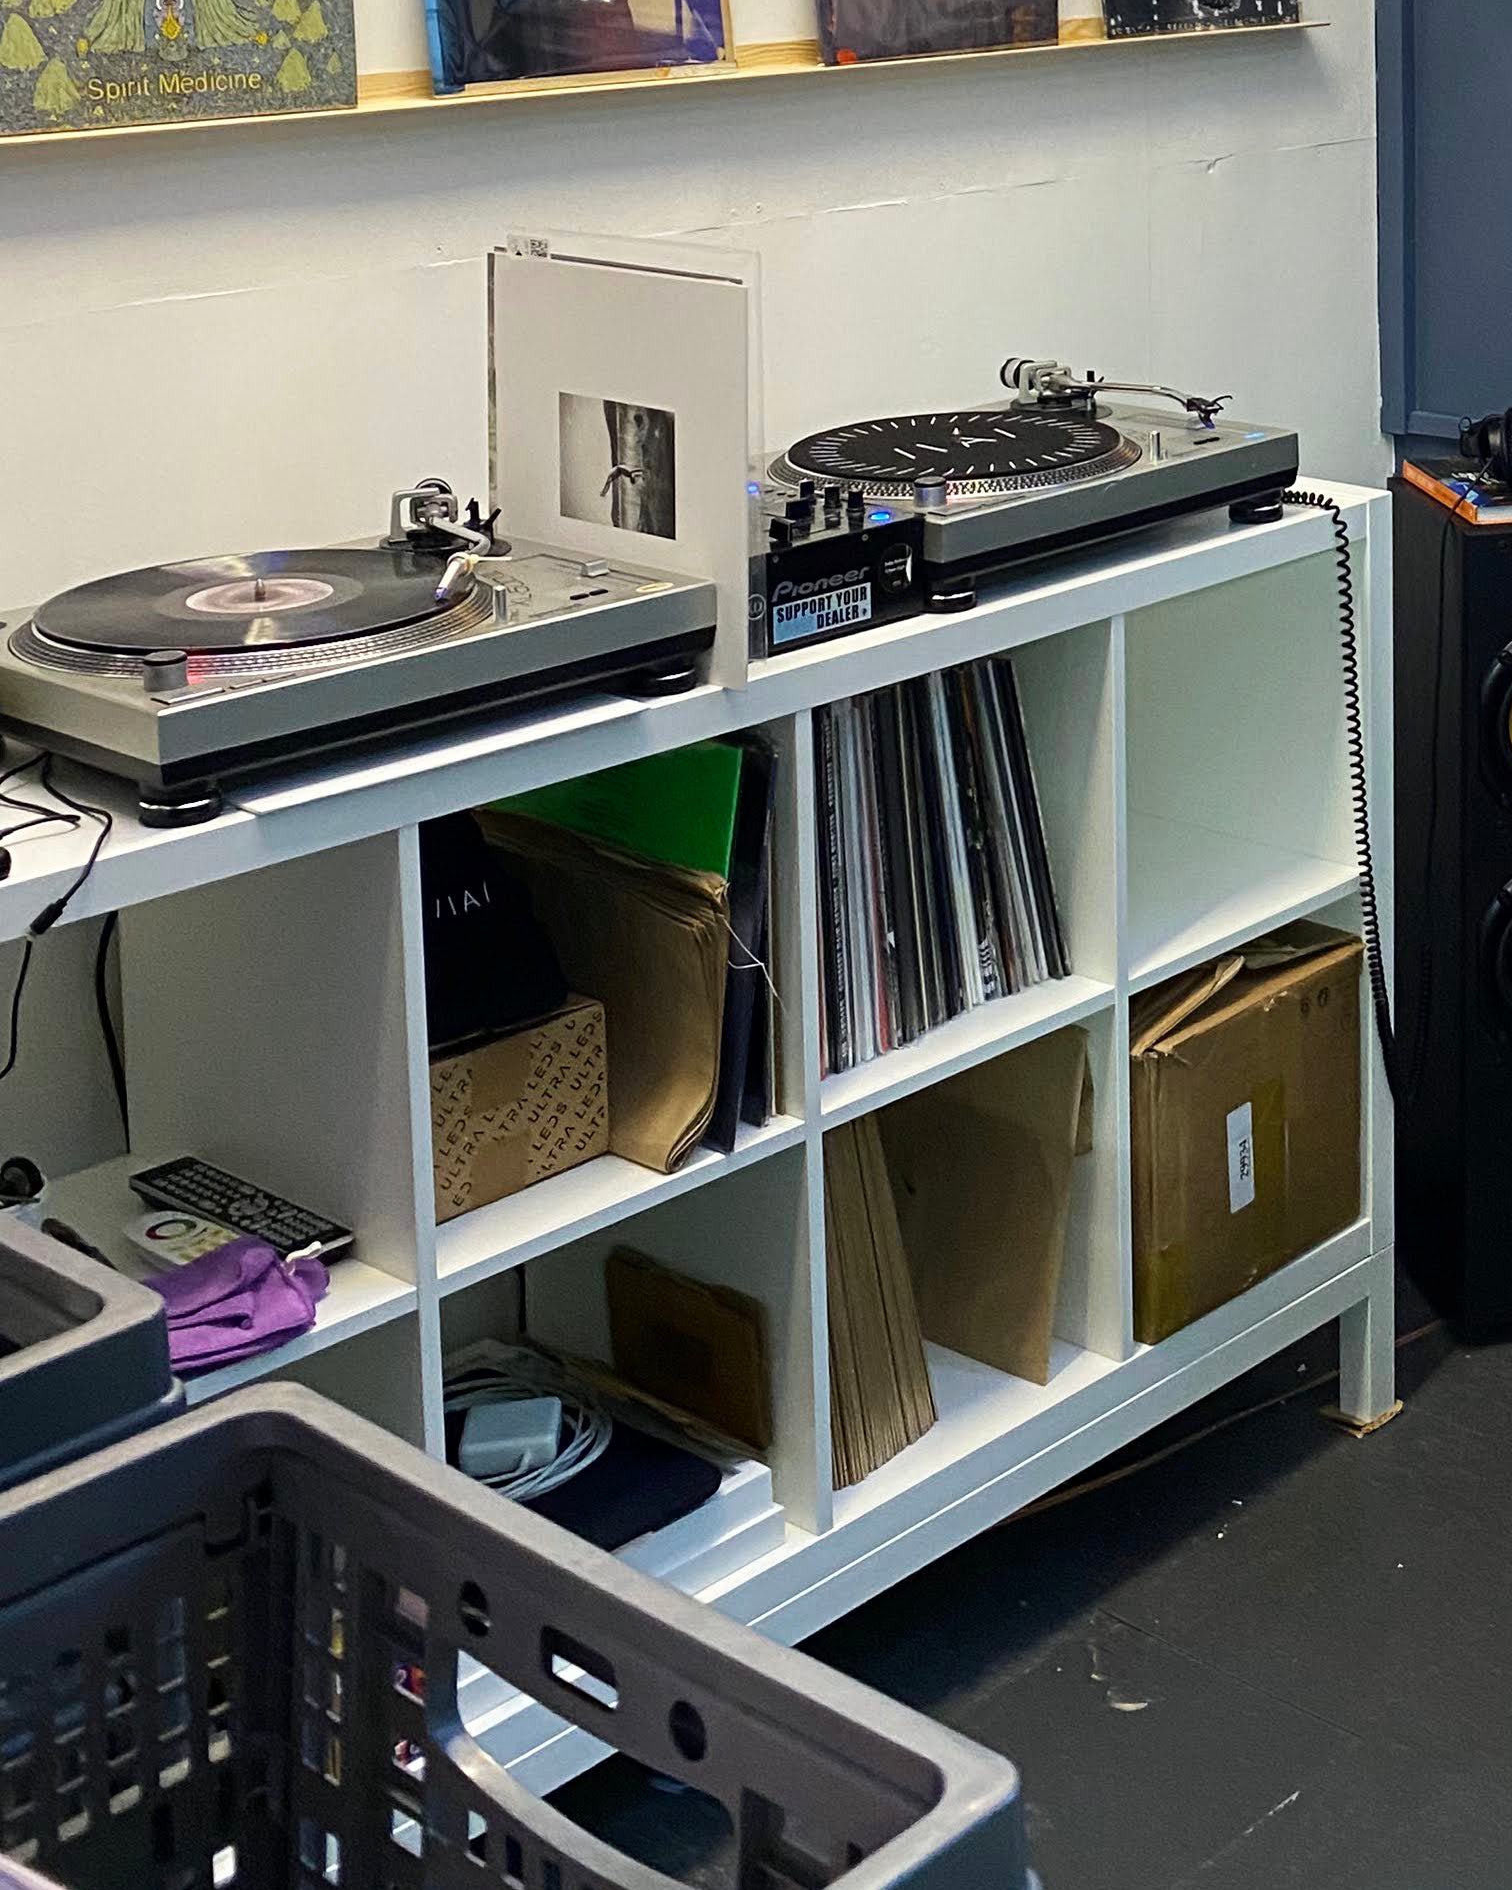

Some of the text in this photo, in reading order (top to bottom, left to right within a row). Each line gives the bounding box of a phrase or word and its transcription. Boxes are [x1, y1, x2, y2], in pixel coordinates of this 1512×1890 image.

[87, 68, 263, 100] Spirit Medicine
[771, 566, 870, 602] Pioneer
[776, 585, 867, 624] SUPPORT YOUR
[816, 604, 860, 630] DEALER
[570, 1045, 604, 1091] ULTR
[527, 1064, 571, 1123] ULTRA
[532, 1101, 567, 1151] LEDS
[441, 1130, 484, 1190] ULTRA
